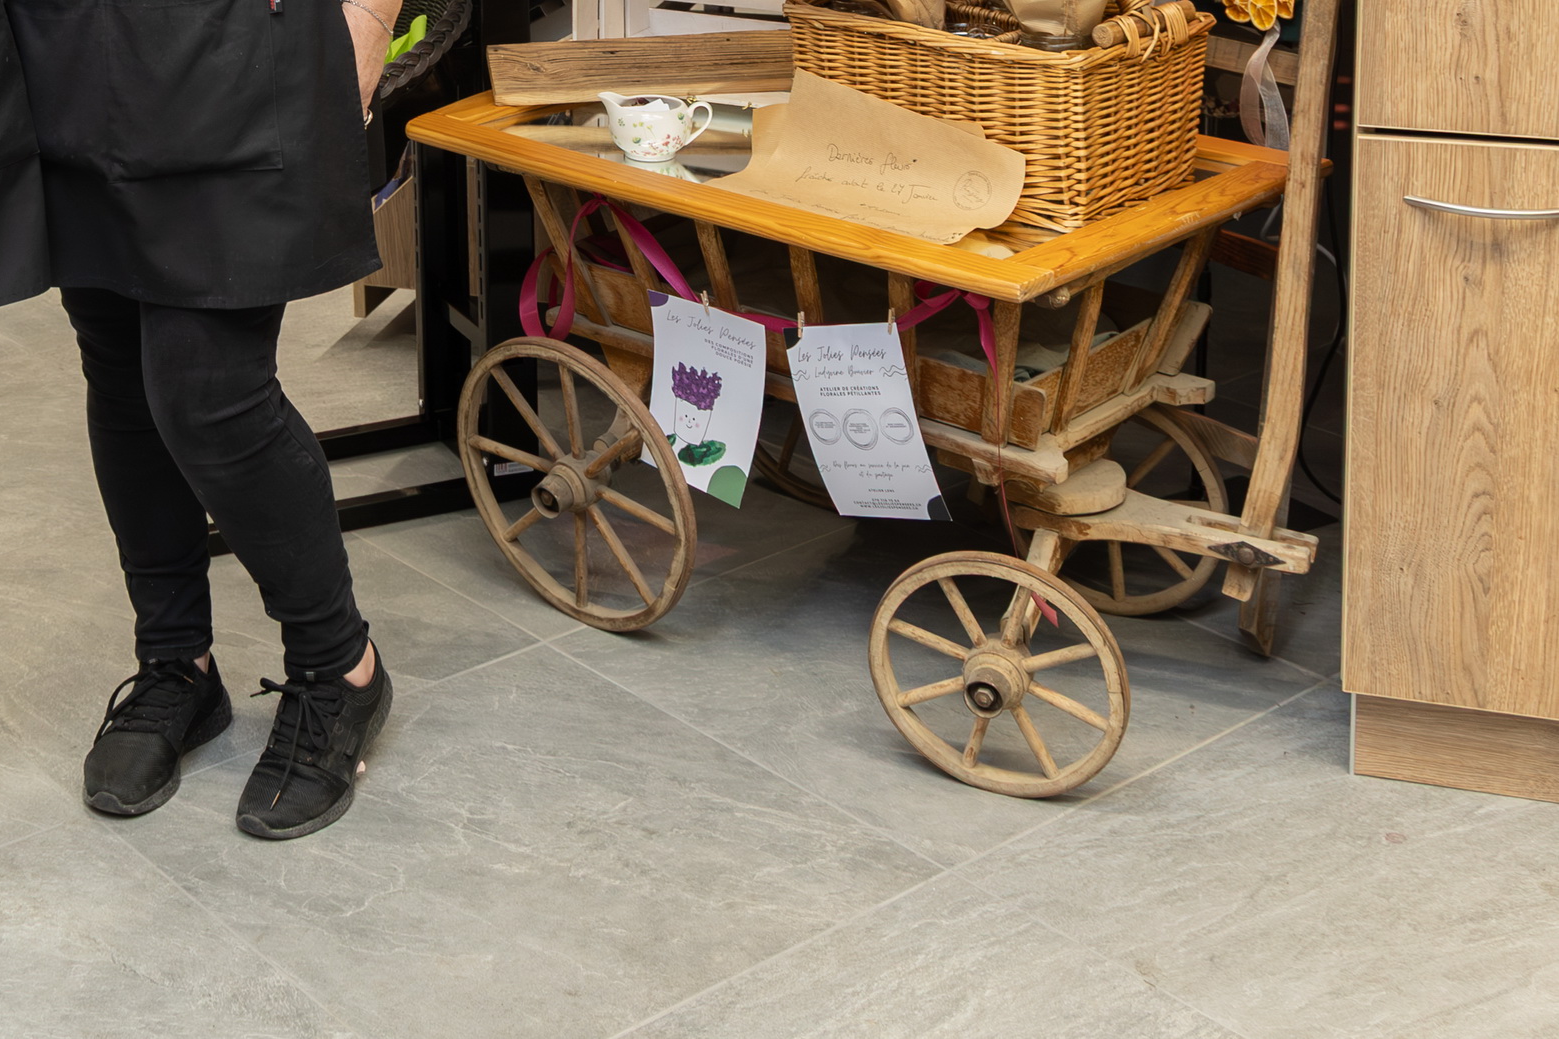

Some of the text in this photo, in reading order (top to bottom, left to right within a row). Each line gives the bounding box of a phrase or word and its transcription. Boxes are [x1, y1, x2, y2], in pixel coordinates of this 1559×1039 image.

[827, 143, 873, 166] Dernières
[667, 310, 756, 349] Les Jolies Pensées
[711, 345, 753, 364] FLORALES D'UNE
[715, 342, 753, 359] COMPOSITIONS
[716, 352, 732, 361] DOUCE
[798, 344, 886, 362] Les Jolies Pensées
